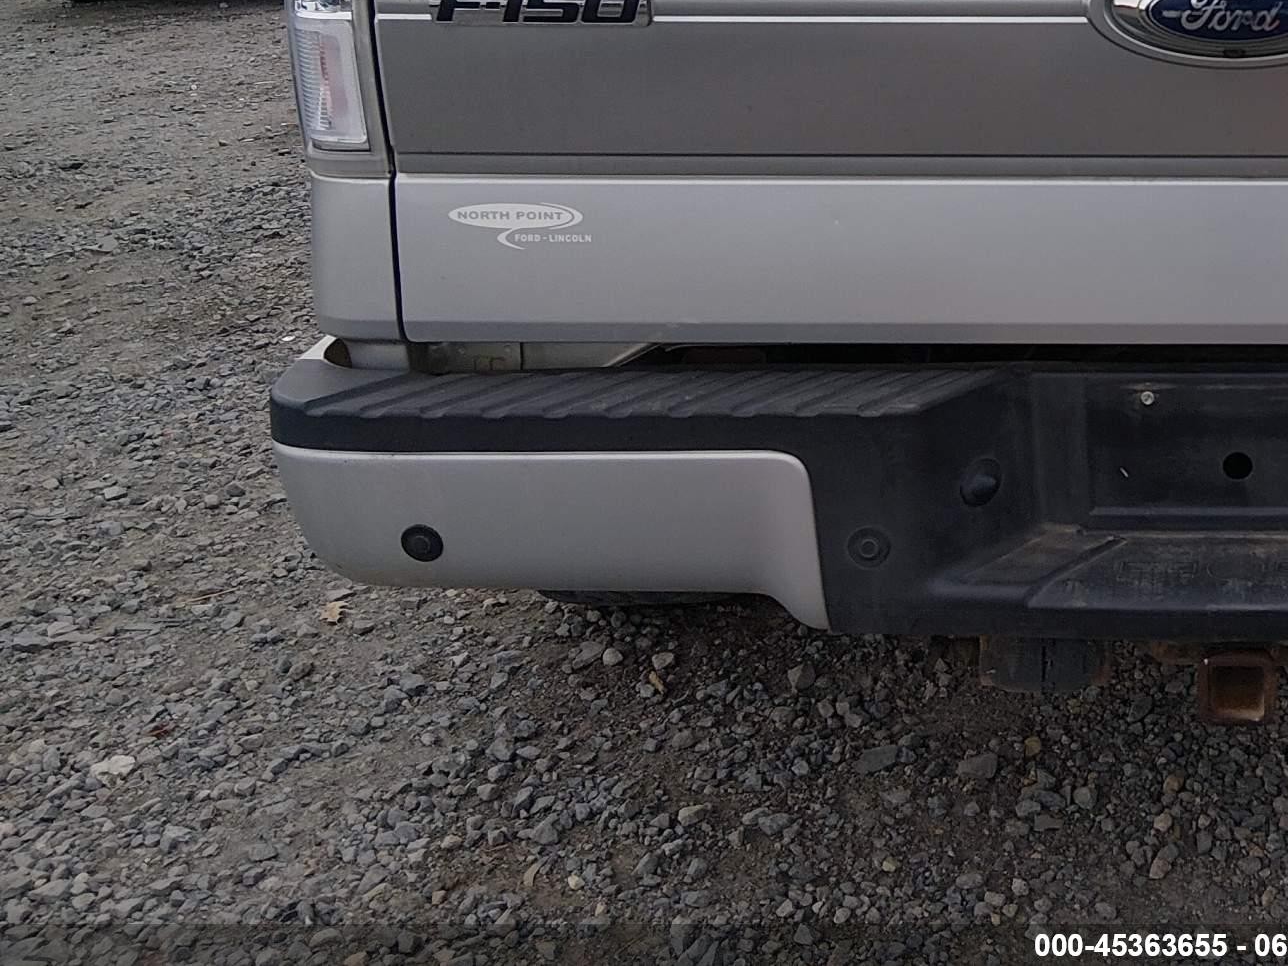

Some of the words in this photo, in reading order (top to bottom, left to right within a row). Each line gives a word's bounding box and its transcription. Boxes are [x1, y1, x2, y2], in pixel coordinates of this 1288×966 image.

[457, 210, 510, 220] NORTH
[516, 210, 564, 220] POINT
[514, 234, 541, 243] FORD
